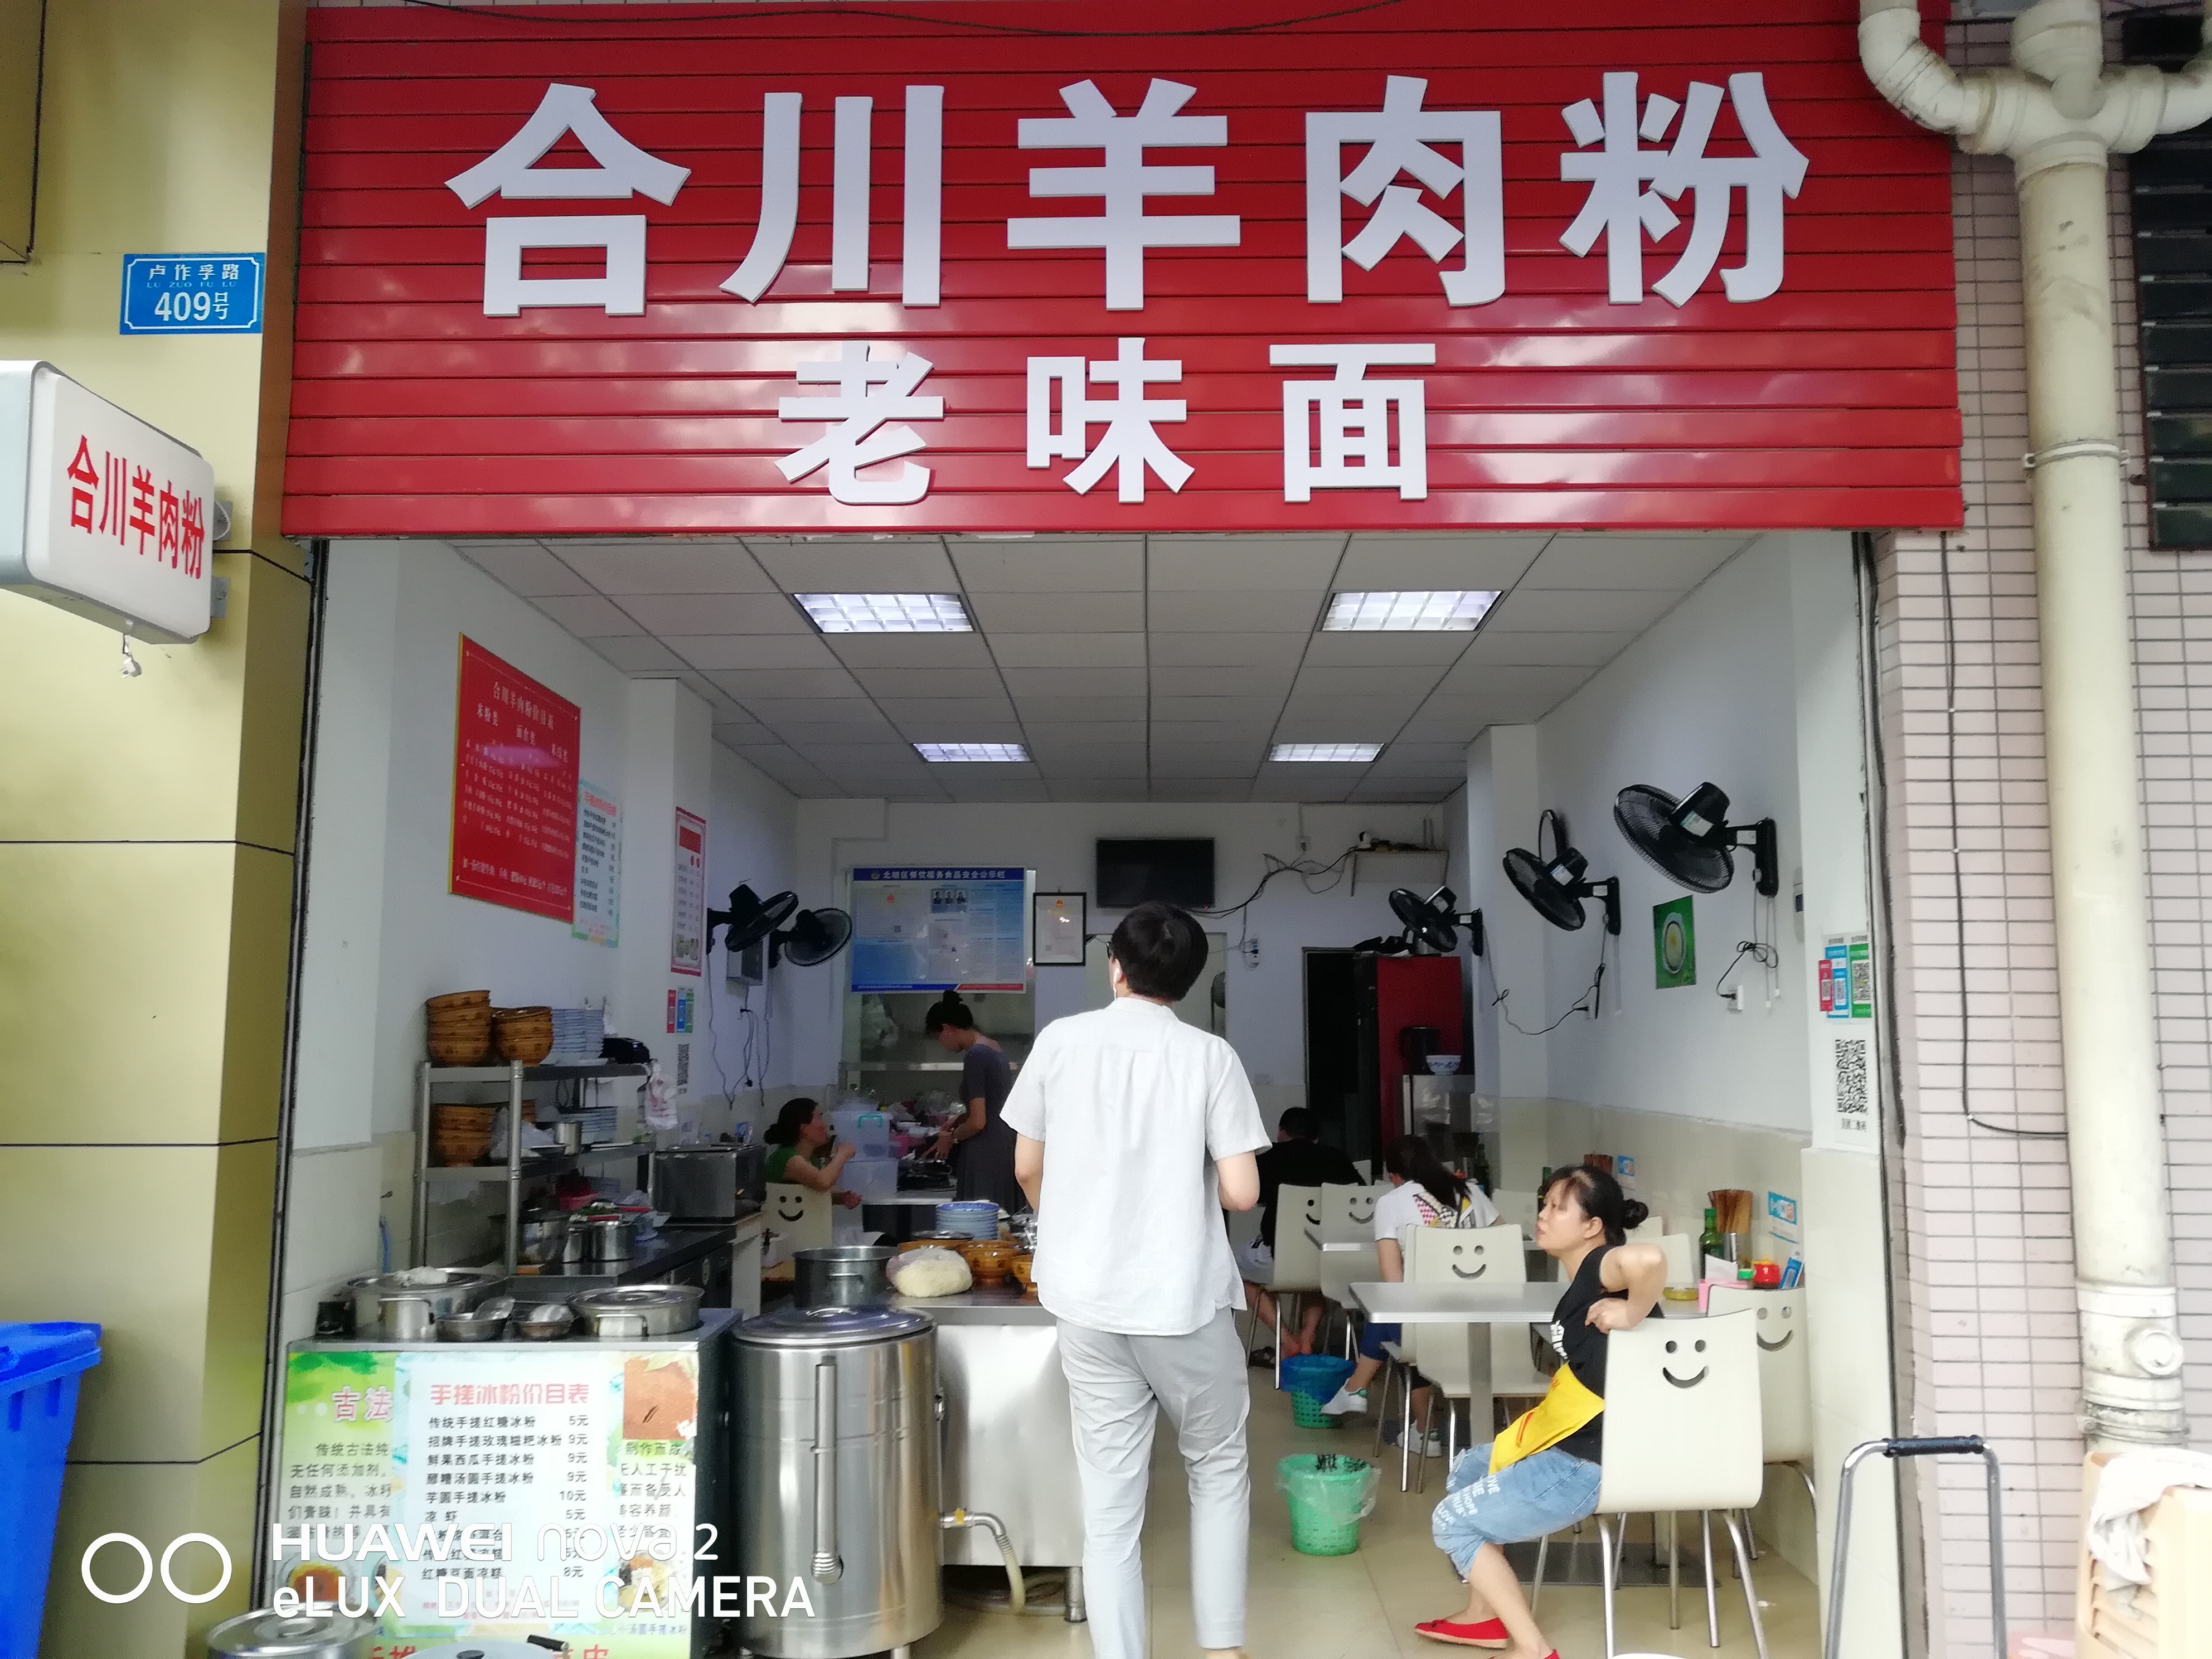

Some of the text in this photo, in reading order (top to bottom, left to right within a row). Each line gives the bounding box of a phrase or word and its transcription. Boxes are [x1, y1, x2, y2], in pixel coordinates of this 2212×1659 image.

[444, 71, 1810, 317] 合川羊肉粉
[149, 264, 240, 280] 卢作孚路
[154, 292, 230, 321] 409号
[67, 434, 205, 580] 合川羊肉粉
[430, 1384, 589, 1405] 手搓冰粉价目表
[569, 1415, 589, 1427] 5元
[568, 1434, 588, 1445] 9元
[567, 1452, 588, 1464] 9元
[566, 1471, 587, 1483] 9元
[559, 1490, 586, 1501] 10元
[566, 1508, 586, 1520] 5元
[564, 1566, 584, 1578] 8元
